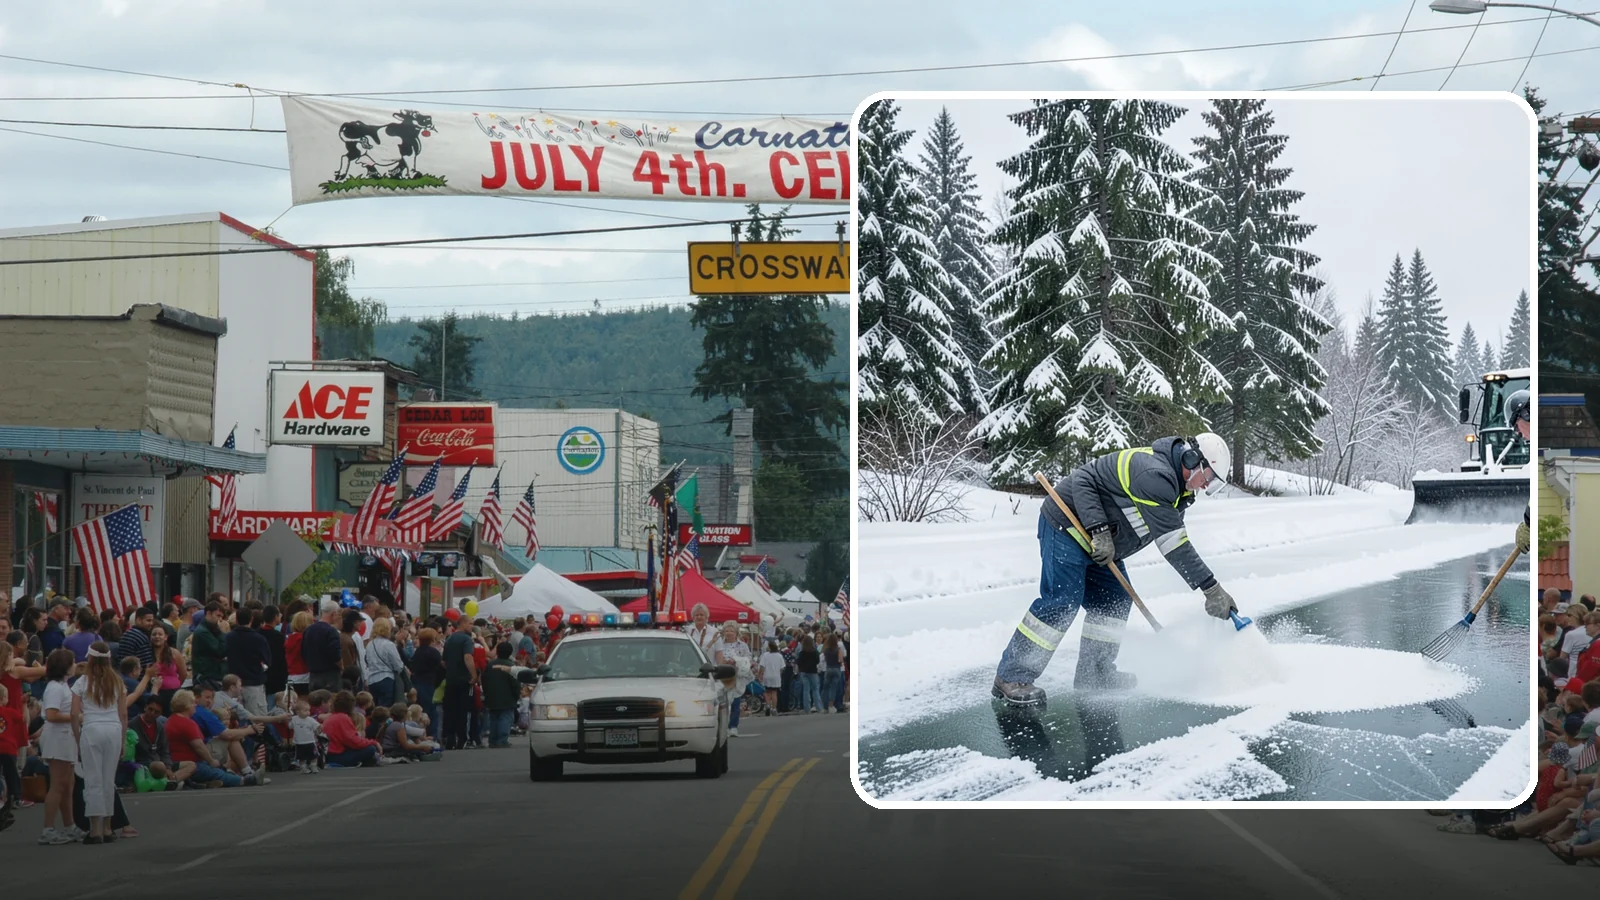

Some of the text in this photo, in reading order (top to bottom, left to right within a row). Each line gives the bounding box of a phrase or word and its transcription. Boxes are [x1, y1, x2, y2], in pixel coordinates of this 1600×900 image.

[695, 121, 850, 150] Carnat
[481, 141, 605, 192] JULY
[632, 150, 746, 197] 4th.
[697, 254, 850, 280] CROSSWA
[283, 380, 373, 420] ACE
[405, 409, 452, 421] CEDAR
[284, 421, 370, 436] Hardware
[353, 467, 386, 480] Simpl
[95, 485, 124, 494] Vincent
[126, 485, 135, 494] de
[138, 486, 155, 495] Paul
[688, 526, 741, 535] CRNATION
[699, 535, 730, 543] GLASS
